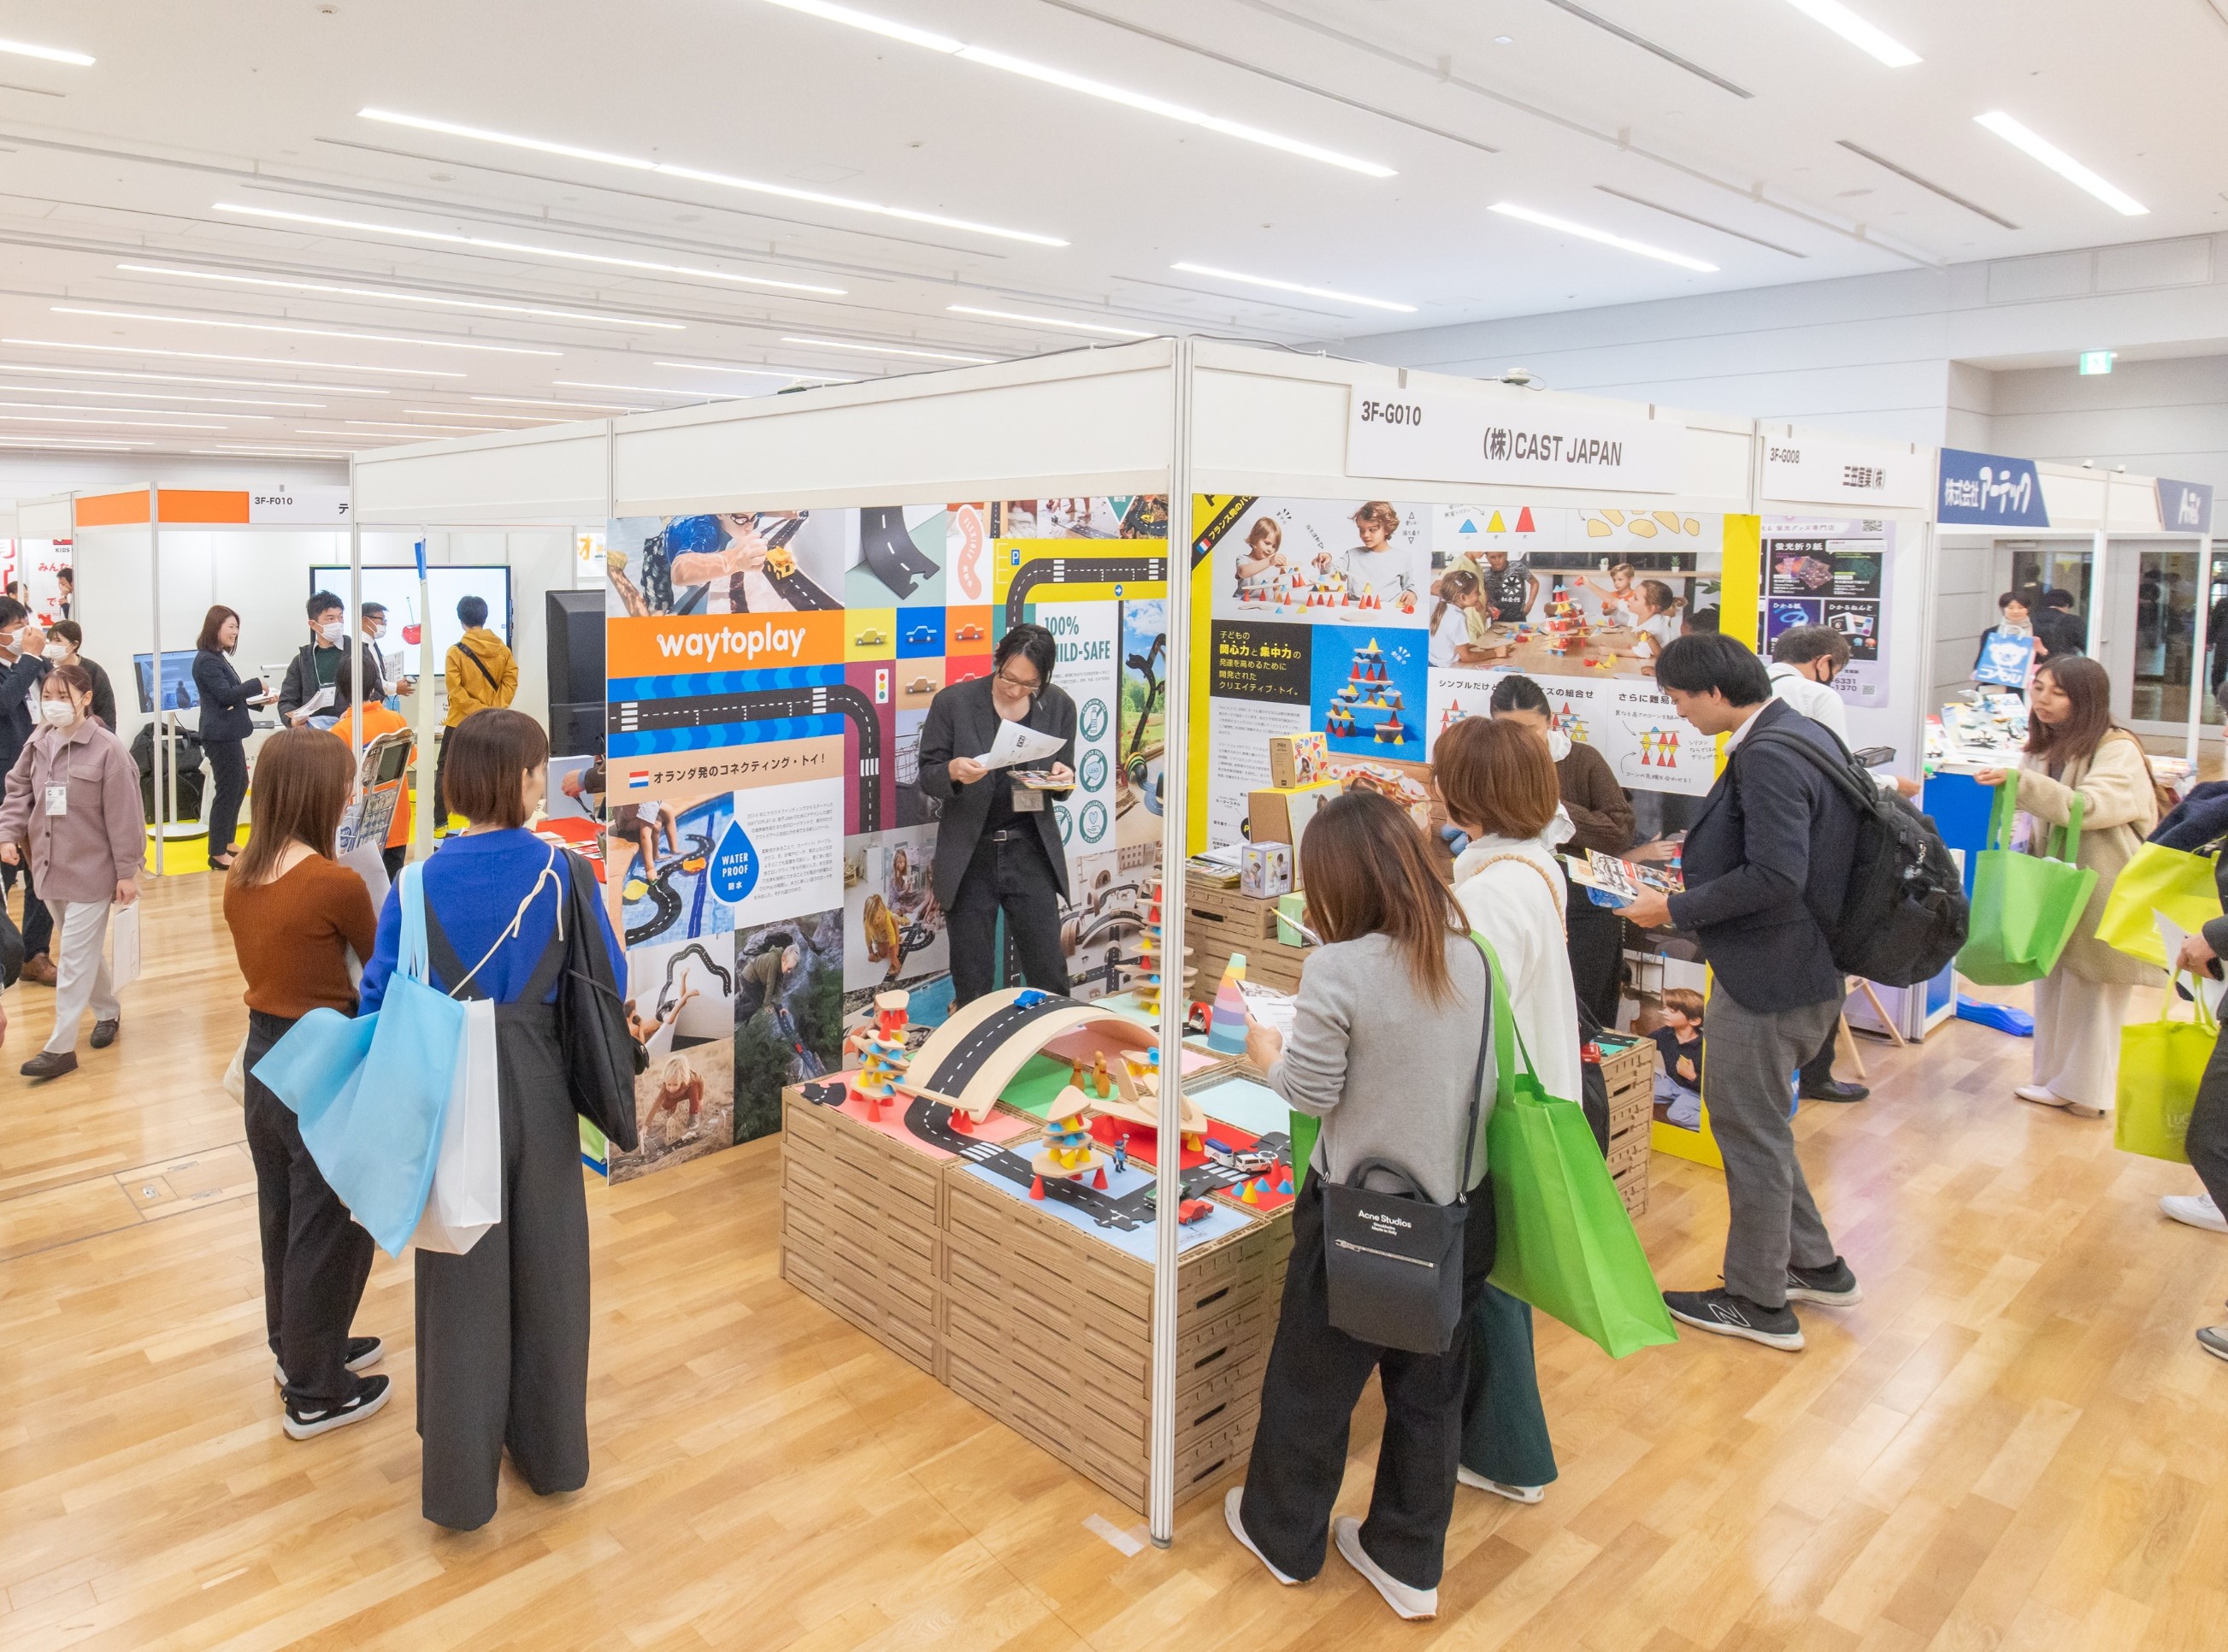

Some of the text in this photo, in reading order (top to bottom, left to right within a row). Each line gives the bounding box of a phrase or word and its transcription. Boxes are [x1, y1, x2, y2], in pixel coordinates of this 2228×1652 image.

[1362, 401, 1421, 426] 3F-G010
[1483, 427, 1623, 466] (株)CAST JAPAN
[1770, 447, 1800, 463] 3F-G008
[254, 497, 293, 505] 3F-F010
[38, 562, 74, 572] みんな
[1045, 616, 1080, 636] 100%
[1220, 630, 1251, 640] 子どもの
[657, 622, 806, 663] waytoplay
[1219, 658, 1288, 670] 発達を高めるために
[1219, 670, 1258, 681] 開発された
[1618, 693, 1677, 705] さらに難易
[653, 753, 826, 784] オランダ発のコネクティング・トイ!
[722, 852, 749, 865] WATER
[722, 864, 749, 878] PROOF
[728, 881, 743, 891] 防水
[1358, 1209, 1412, 1229] Acne Studios
